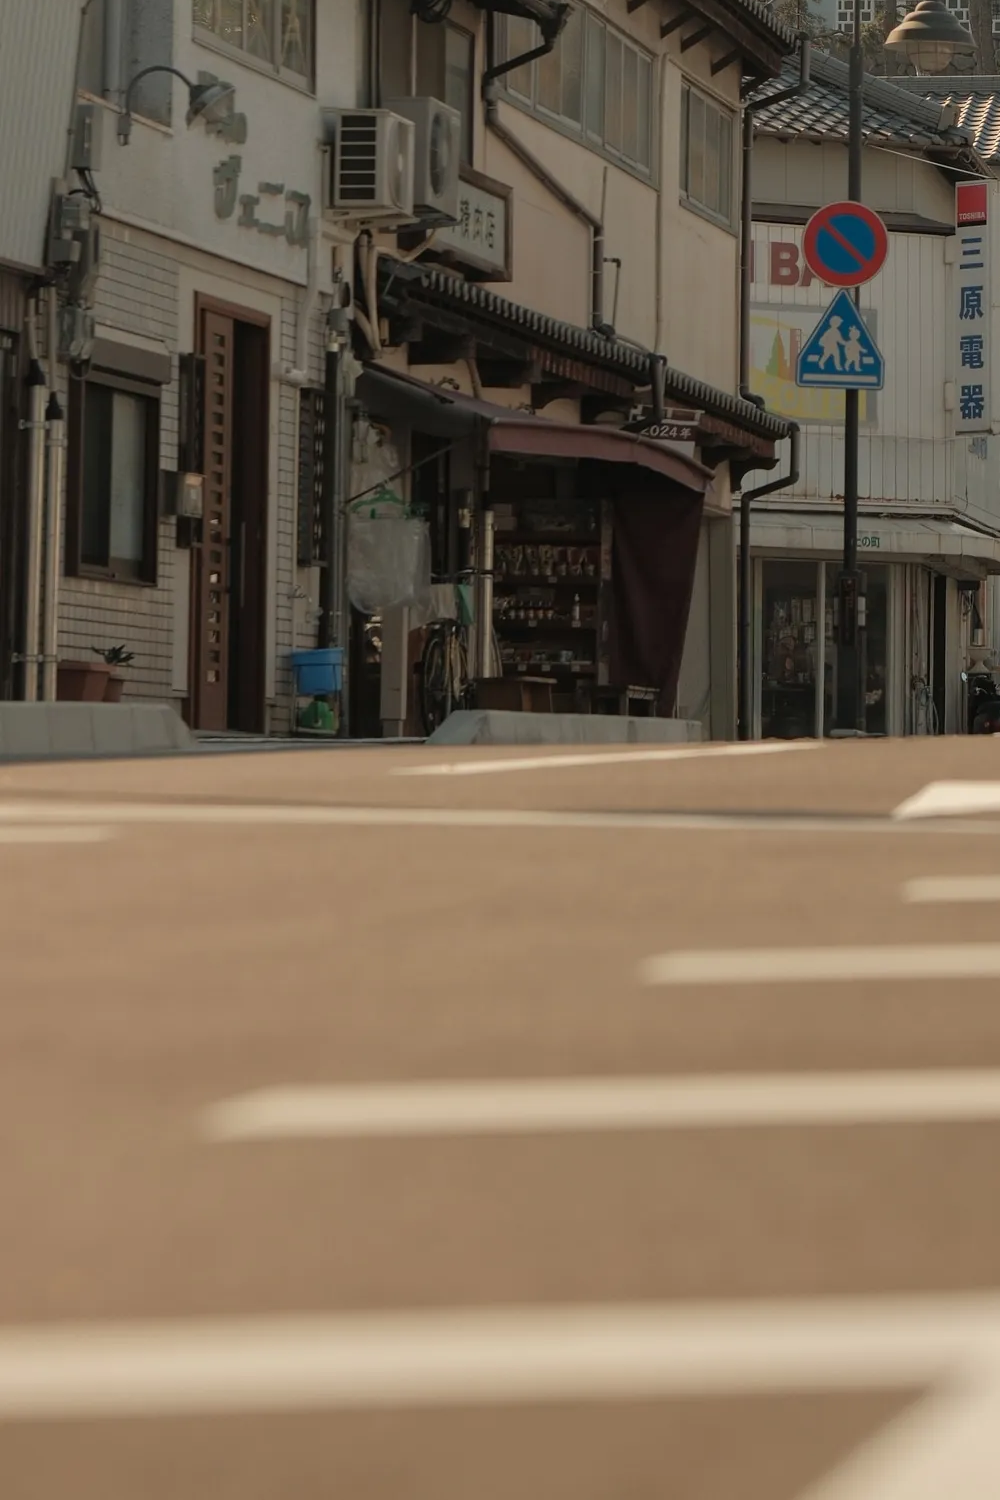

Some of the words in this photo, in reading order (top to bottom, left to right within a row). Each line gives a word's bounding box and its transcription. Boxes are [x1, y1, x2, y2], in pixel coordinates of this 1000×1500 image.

[959, 211, 986, 221] TOSHIBA
[959, 236, 985, 420] 三原電器
